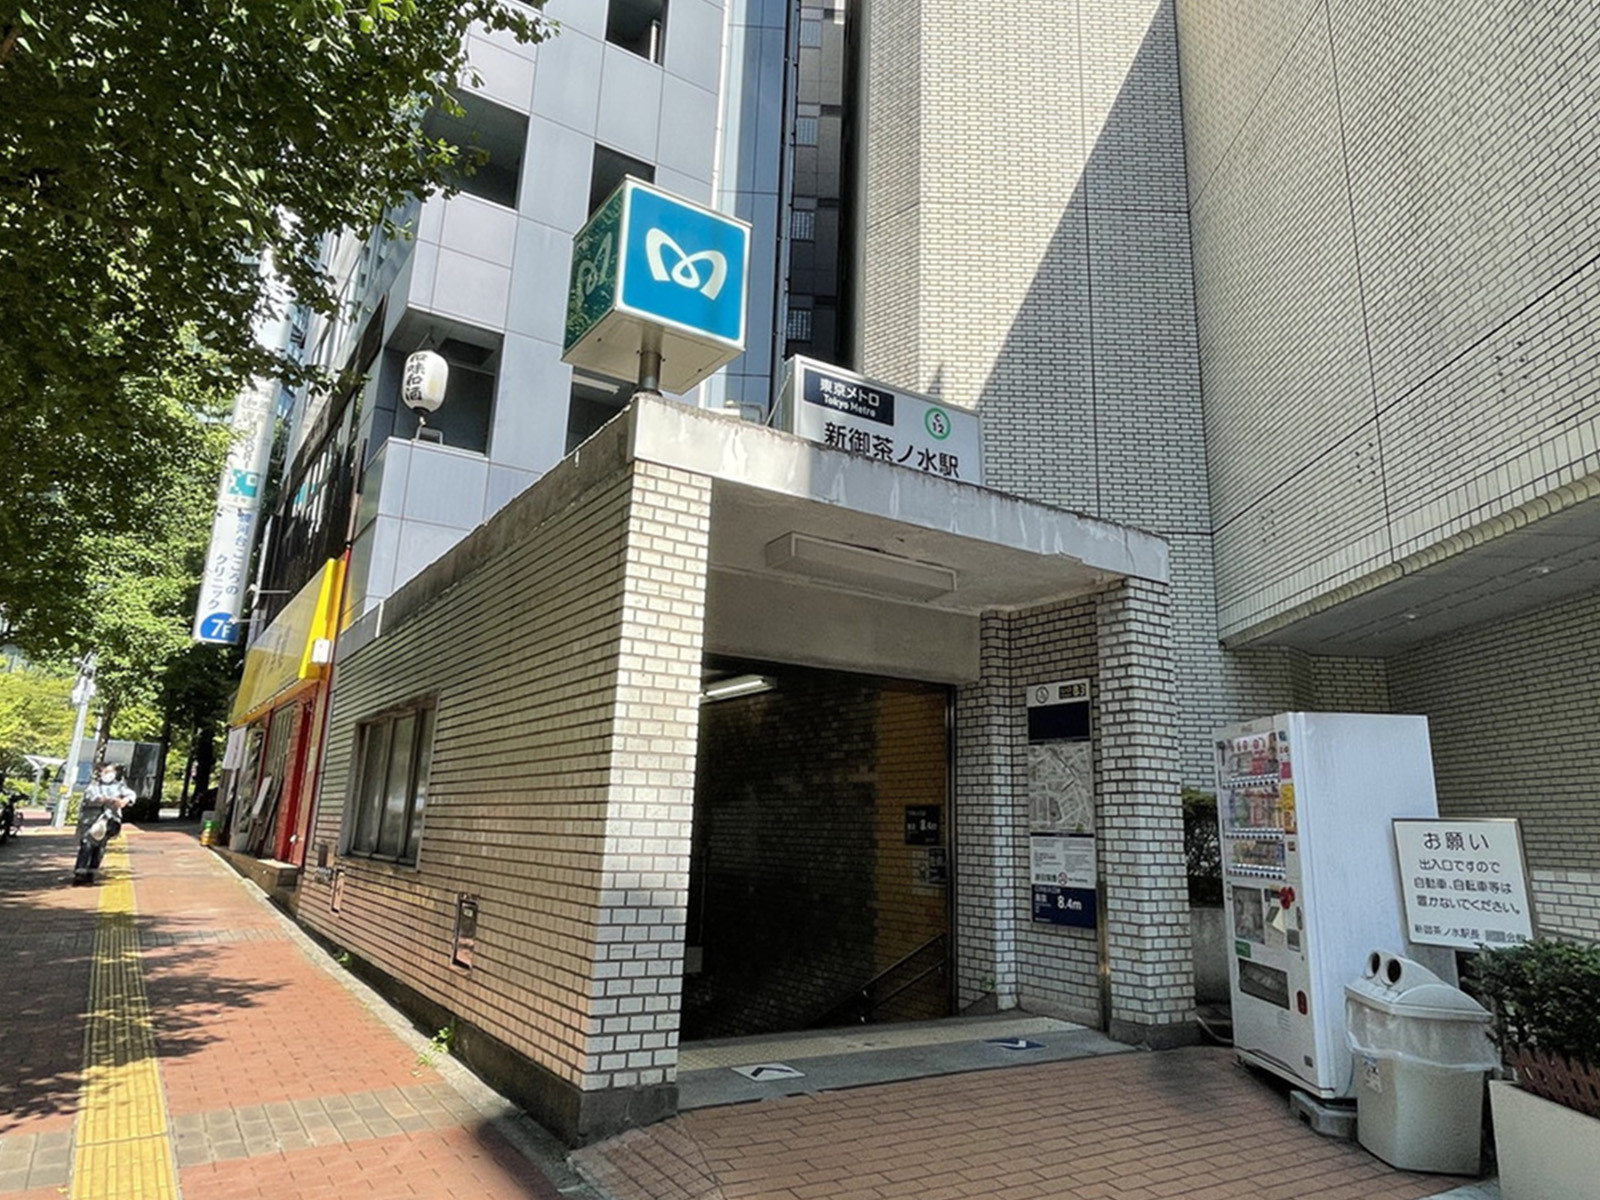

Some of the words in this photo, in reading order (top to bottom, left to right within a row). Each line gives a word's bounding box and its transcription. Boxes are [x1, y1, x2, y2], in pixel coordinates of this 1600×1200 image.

[819, 378, 880, 407] 東京メトロ
[823, 393, 849, 411] Tokyo
[849, 398, 876, 418] Metro
[933, 413, 942, 423] C
[932, 422, 944, 435] 12
[824, 422, 960, 479] 新御茶ノ水駅
[208, 554, 228, 610] クリニック
[211, 618, 232, 639] 7F
[1422, 831, 1490, 851] お願い
[1419, 858, 1501, 873] 出入口ですので
[1414, 877, 1512, 894] 自動車、自転車等は
[1057, 895, 1082, 911] 8.4m
[1416, 894, 1521, 915] 置かないでください。
